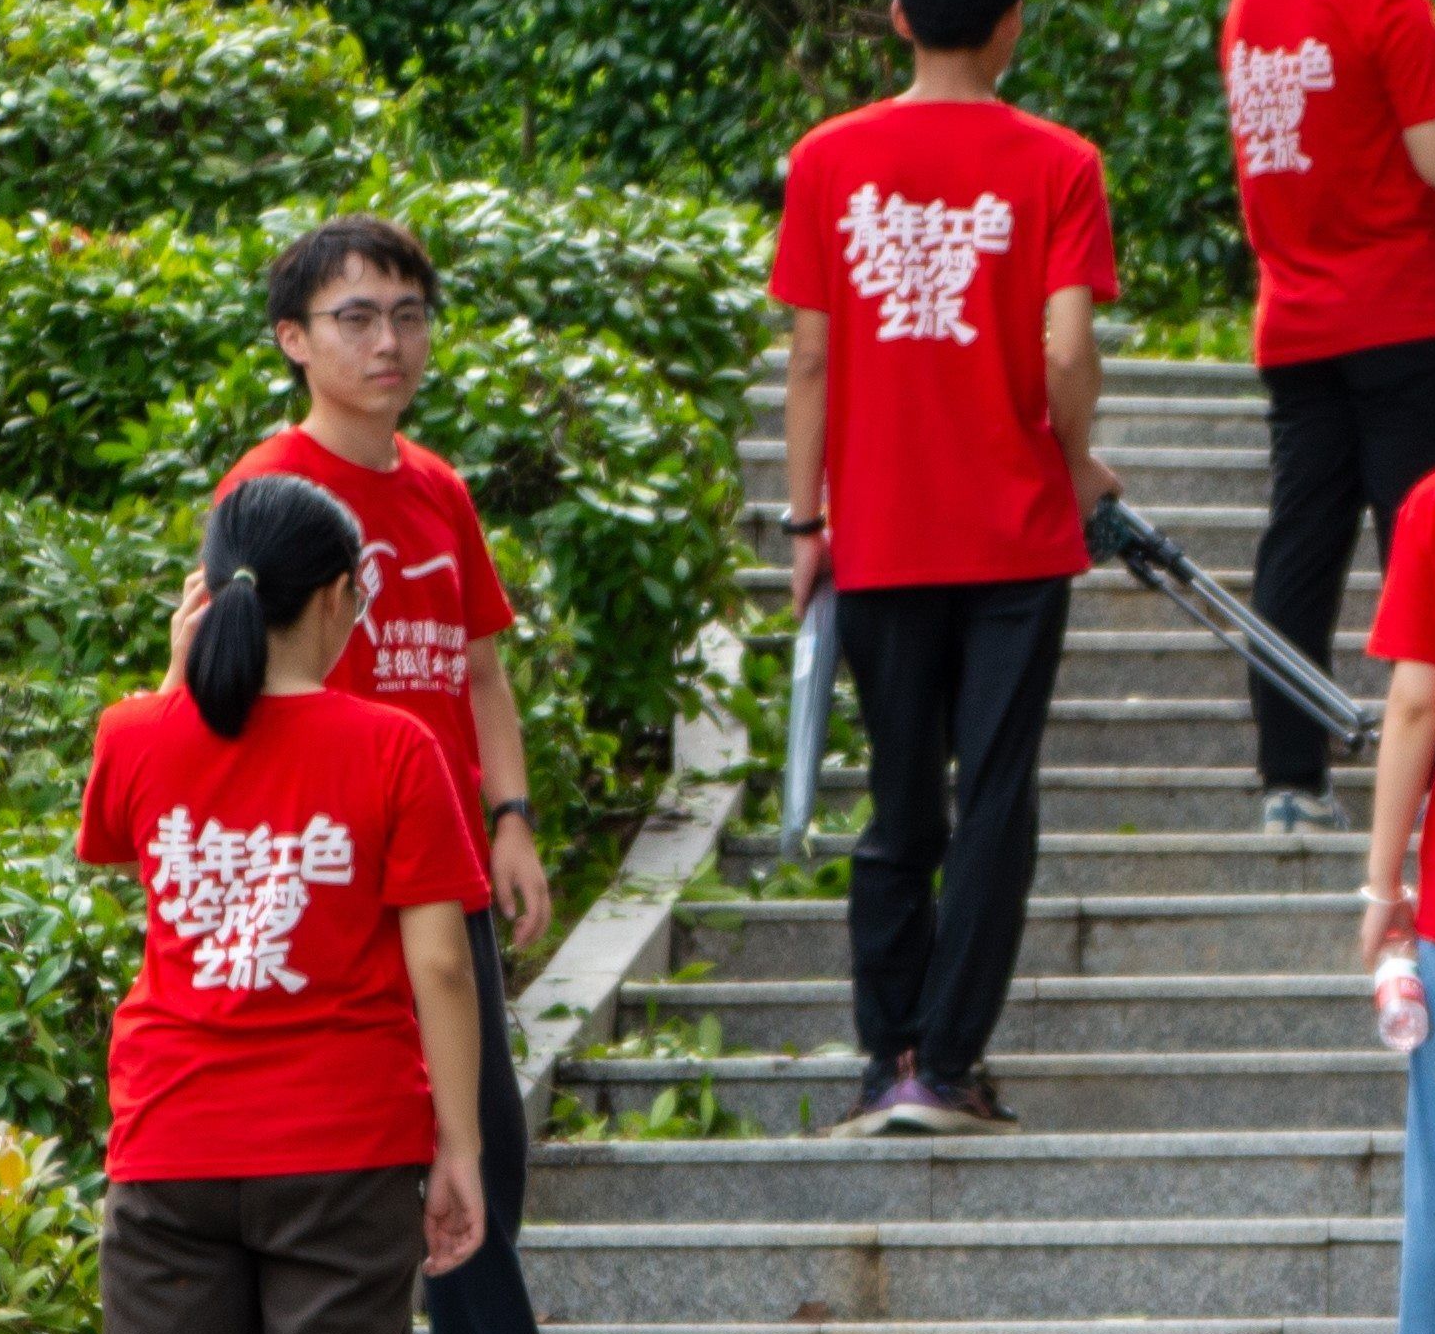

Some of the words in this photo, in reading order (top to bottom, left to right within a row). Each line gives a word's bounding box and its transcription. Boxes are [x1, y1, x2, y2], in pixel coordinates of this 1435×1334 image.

[1245, 131, 1314, 178] 之旅
[836, 181, 1014, 262] 青年红色
[876, 294, 979, 347] 之旅
[147, 804, 354, 897] 青年红色
[169, 877, 312, 944] 筑梦
[191, 936, 309, 994] 之旅
